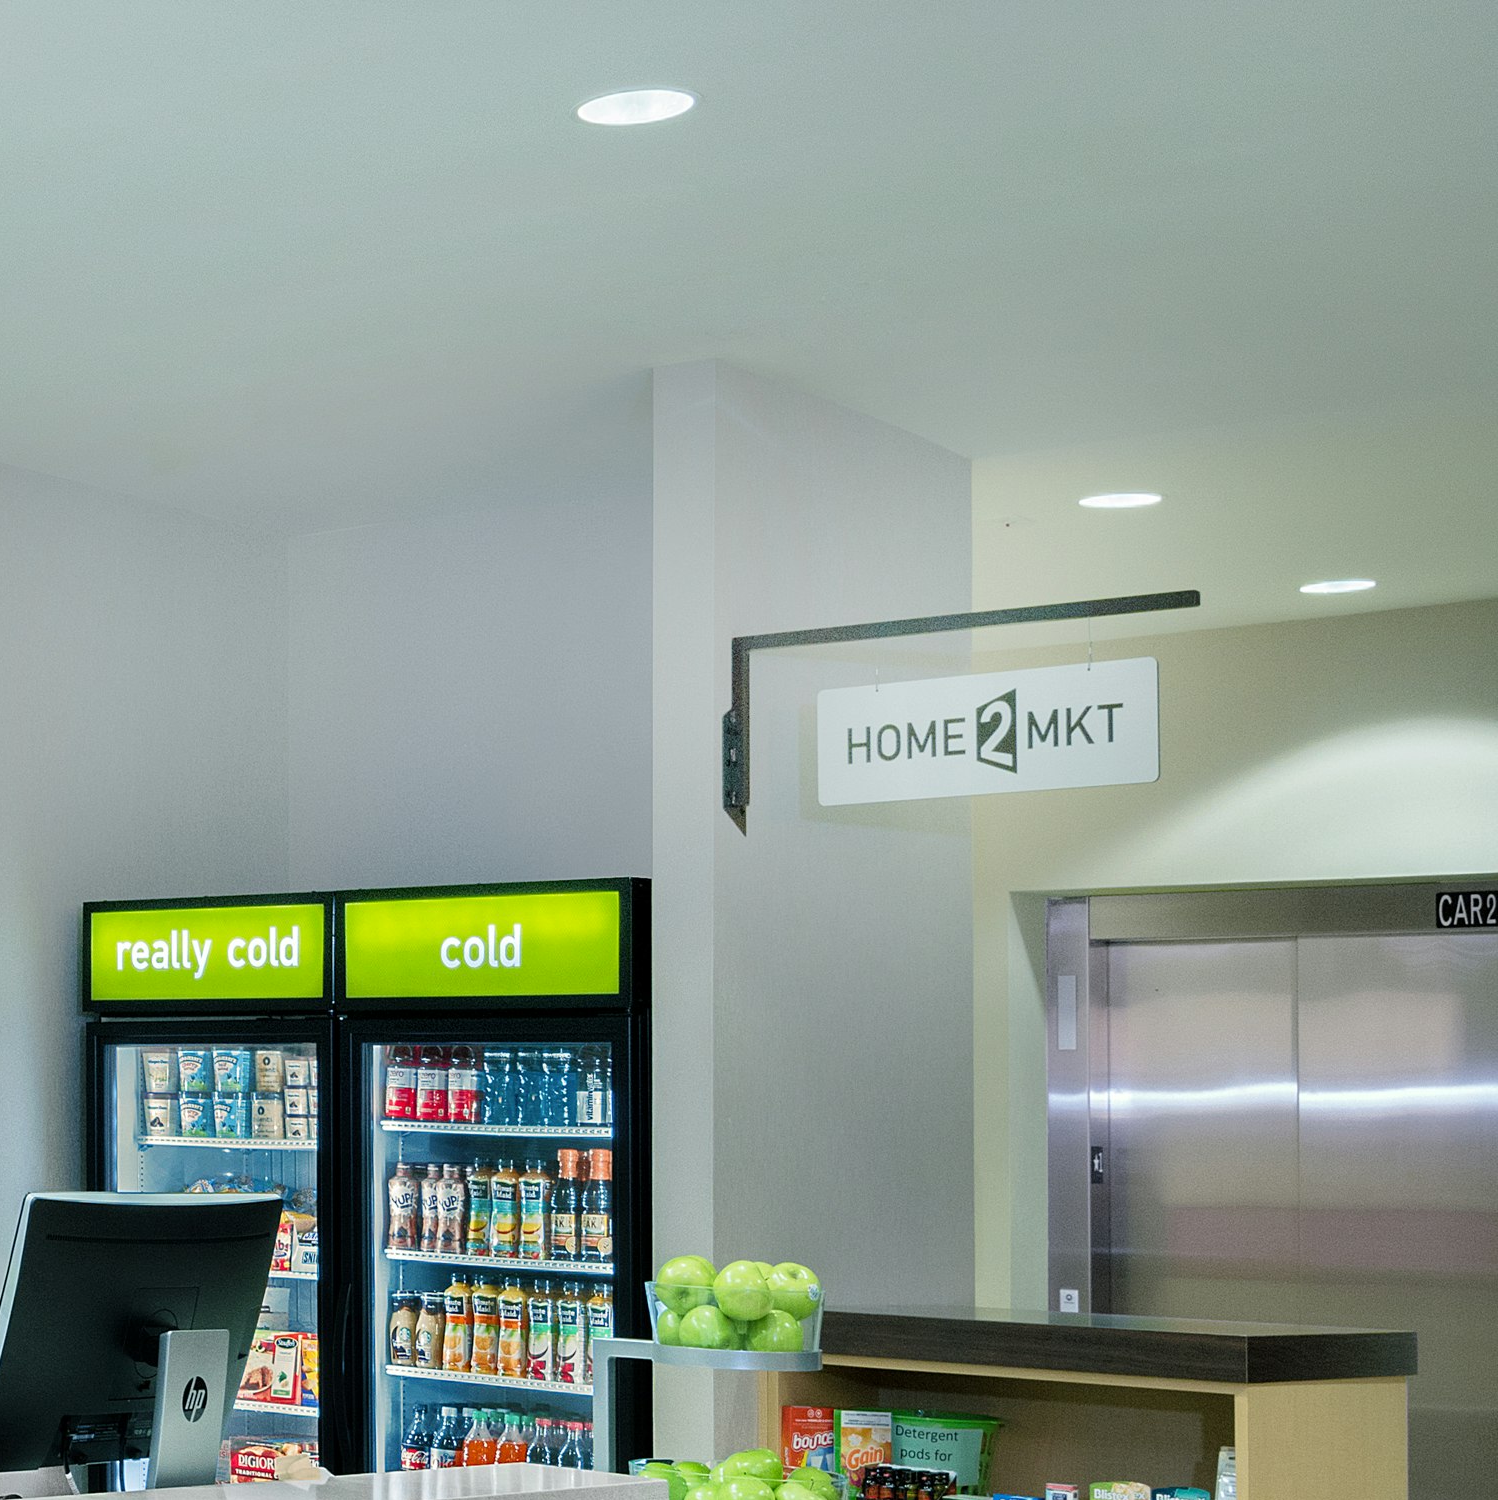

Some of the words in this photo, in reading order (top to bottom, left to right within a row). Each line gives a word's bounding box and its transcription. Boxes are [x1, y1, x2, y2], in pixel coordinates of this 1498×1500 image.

[116, 929, 212, 980] really
[227, 925, 300, 969] cold
[440, 923, 522, 970] cold
[391, 1191, 414, 1208] YUP!
[183, 1377, 207, 1422] hp
[793, 1432, 834, 1451] bounce
[895, 1425, 959, 1443] Detergent
[238, 1454, 276, 1470] DIGIOR
[846, 1446, 884, 1470] Gain
[900, 1447, 931, 1461] pods
[934, 1451, 953, 1462] for
[235, 1468, 273, 1479] TRADITIONAL
